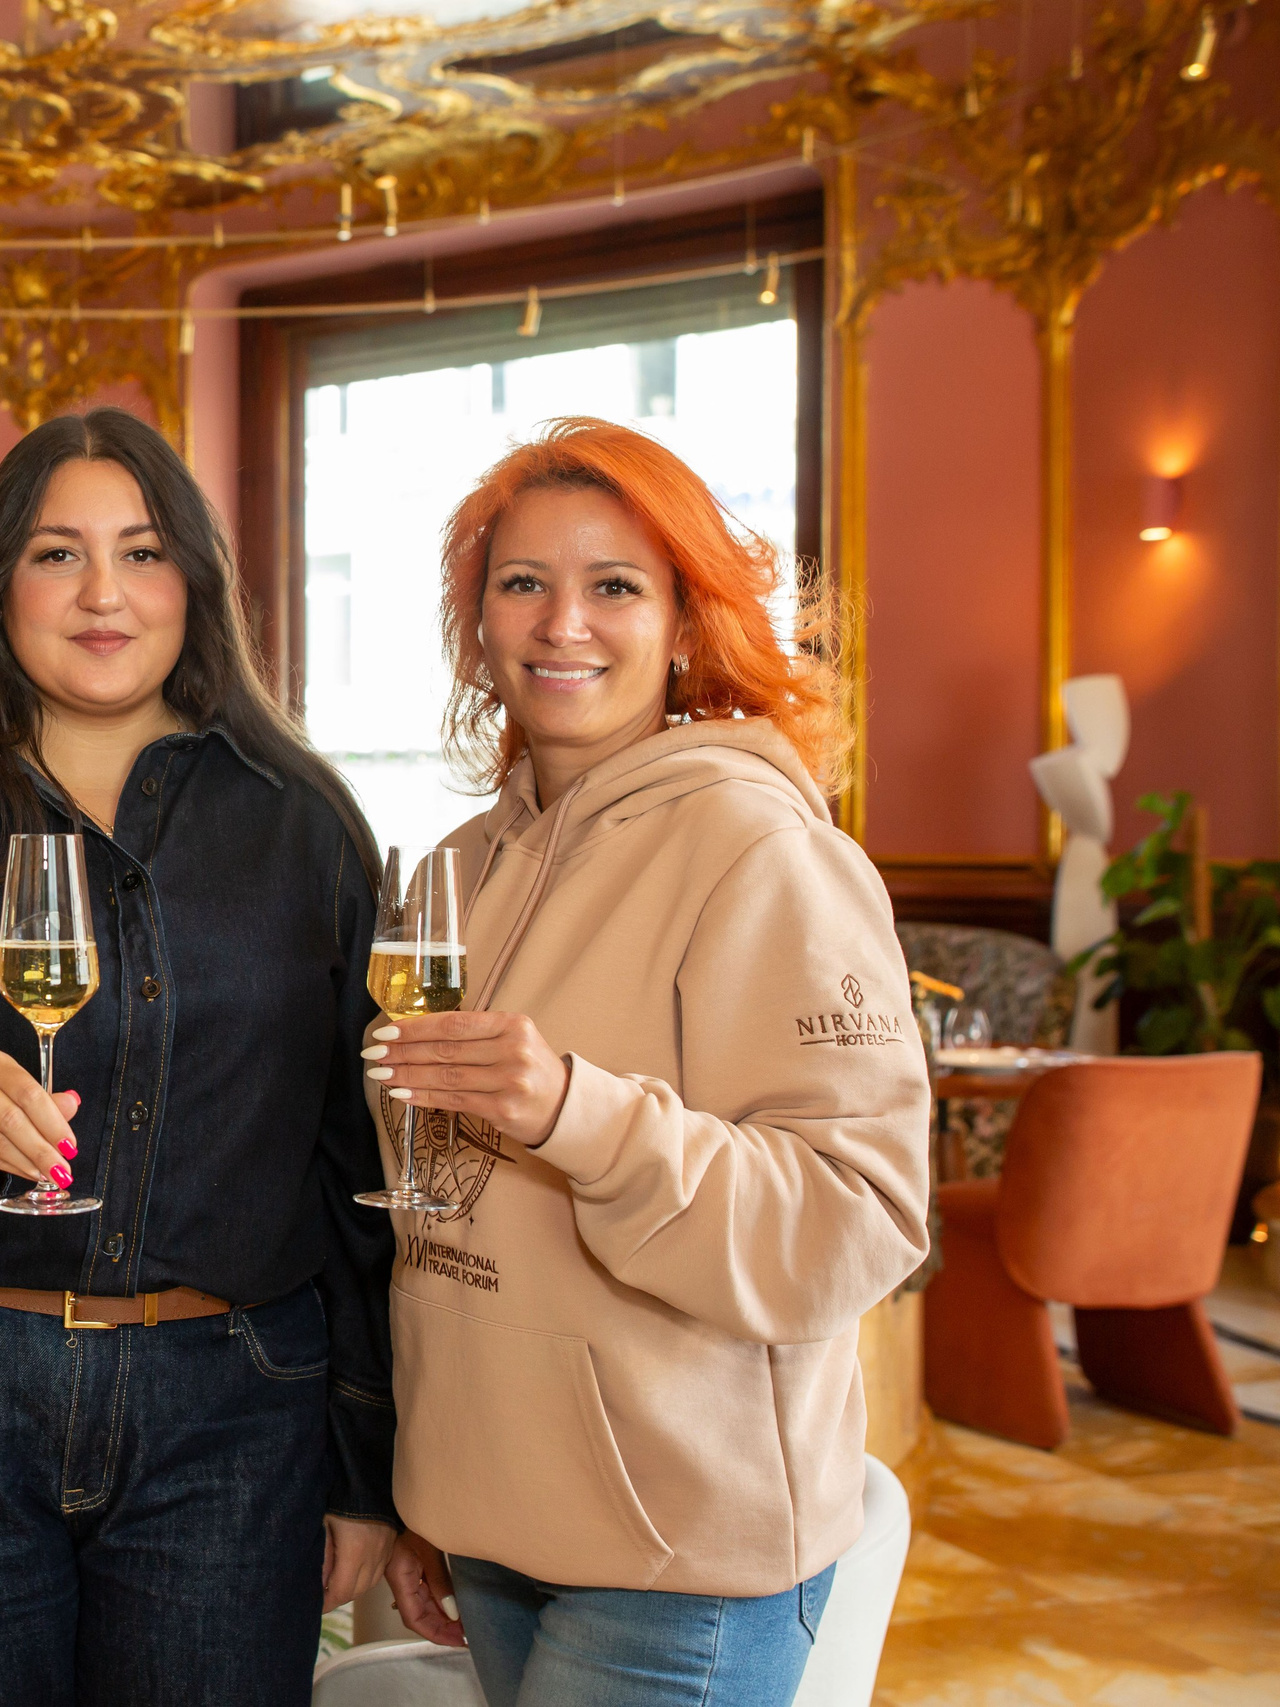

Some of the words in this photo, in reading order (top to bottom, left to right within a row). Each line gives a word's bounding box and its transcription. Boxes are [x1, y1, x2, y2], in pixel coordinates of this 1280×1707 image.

[795, 1012, 903, 1036] NIRVANA
[835, 1033, 886, 1046] HOTELS
[404, 1234, 427, 1272] XVI
[428, 1241, 499, 1274] INTERNATIONAL
[428, 1259, 460, 1282] TRAVEL
[462, 1269, 499, 1293] FORUM
